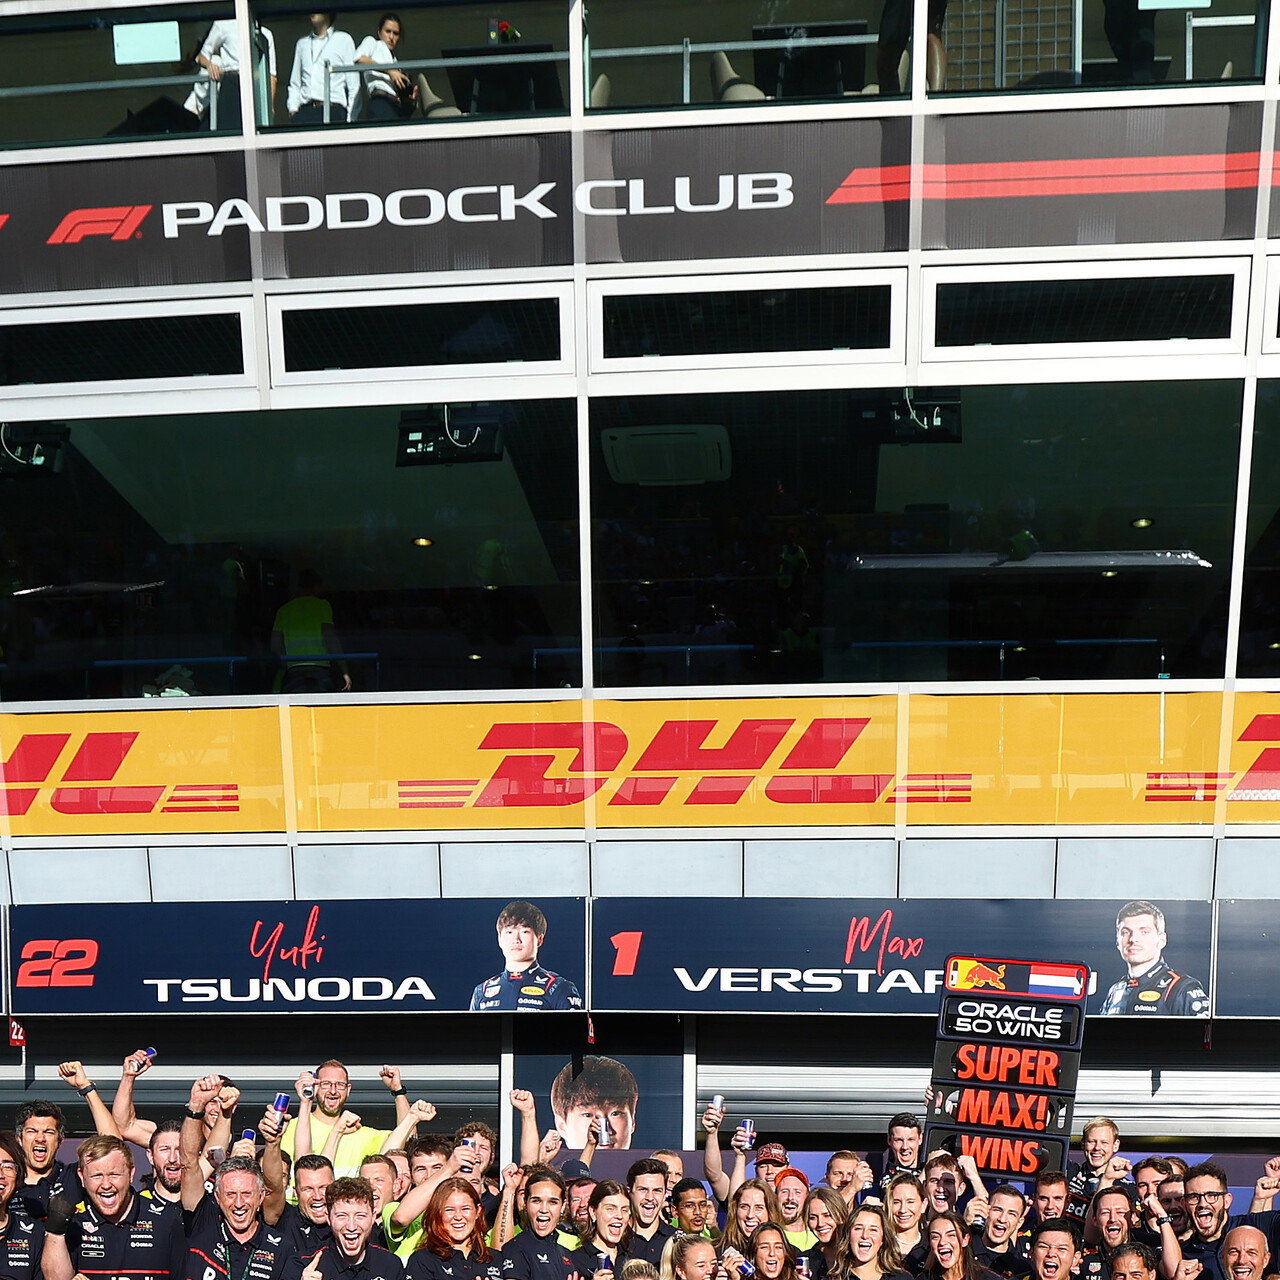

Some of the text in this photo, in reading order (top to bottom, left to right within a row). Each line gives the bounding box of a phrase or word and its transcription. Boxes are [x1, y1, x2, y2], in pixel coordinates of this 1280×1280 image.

[161, 181, 558, 239] PADDOCK
[574, 172, 794, 217] CLUB
[472, 717, 896, 808] DHL
[16, 939, 99, 988] 22
[250, 905, 326, 984] Yuki
[610, 931, 643, 976] 1
[845, 909, 925, 977] Max
[142, 976, 437, 1003] TSUNODA
[11, 1021, 25, 1040] 22
[956, 1019, 1061, 1039] 50 WINS
[958, 1001, 1064, 1024] ORACLE
[957, 1044, 1059, 1087] SUPER
[957, 1088, 1048, 1131] MAX!
[961, 1135, 1040, 1173] WINS
[1065, 1202, 1087, 1217] ed
